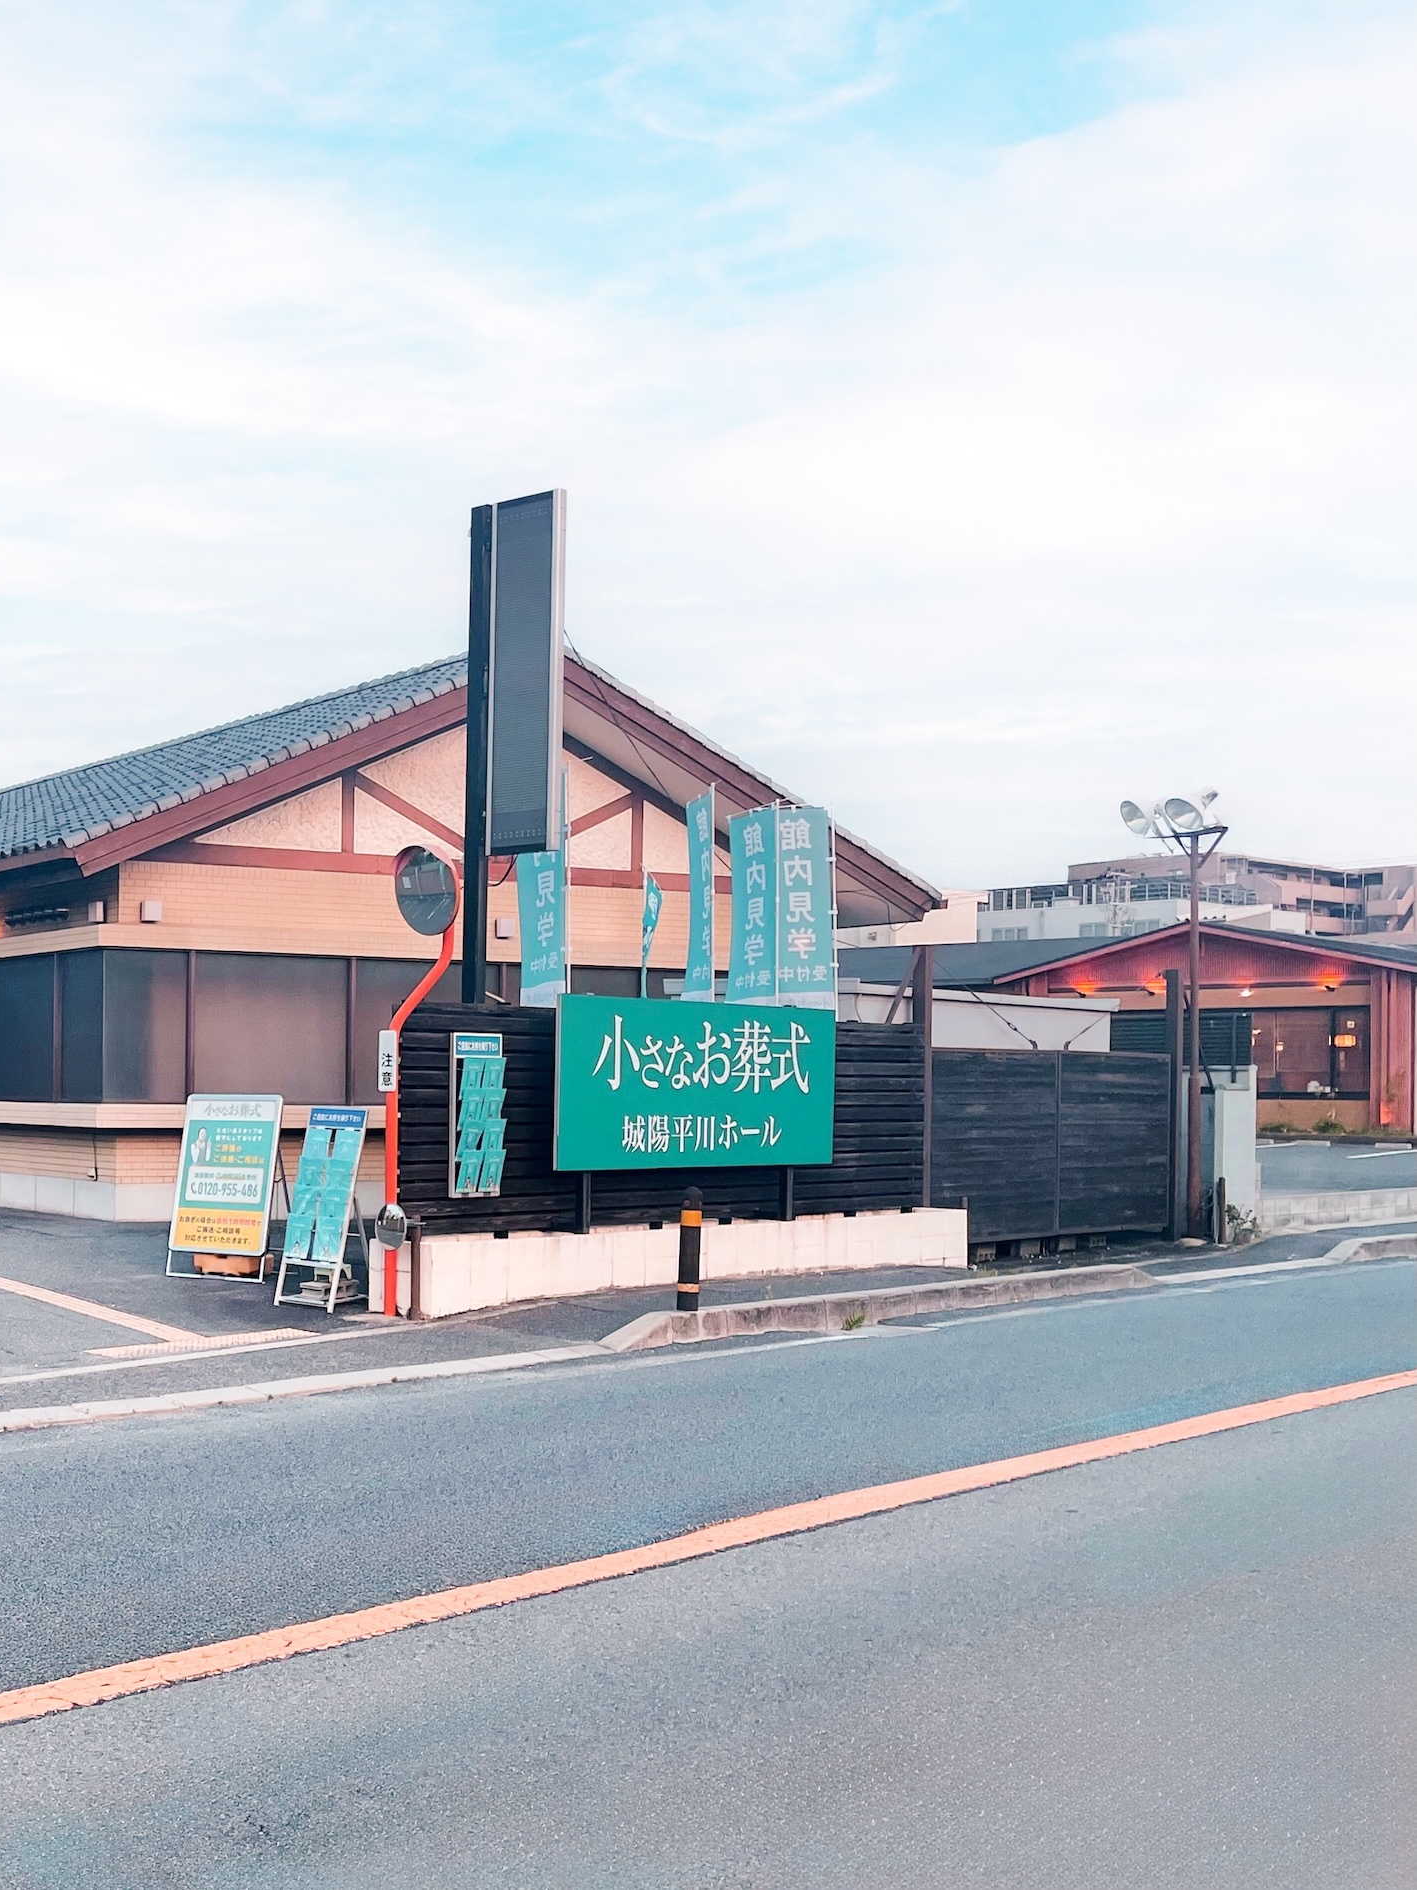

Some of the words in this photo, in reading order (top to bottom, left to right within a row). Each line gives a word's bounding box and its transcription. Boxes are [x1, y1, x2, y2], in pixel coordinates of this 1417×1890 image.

[381, 1053, 393, 1086] 注意
[592, 1014, 811, 1095] 小さなお葬式
[204, 1103, 262, 1117] 小さなお葬式
[622, 1114, 782, 1153] 城陽平川ホール
[197, 1182, 258, 1197] 0120-955-486
